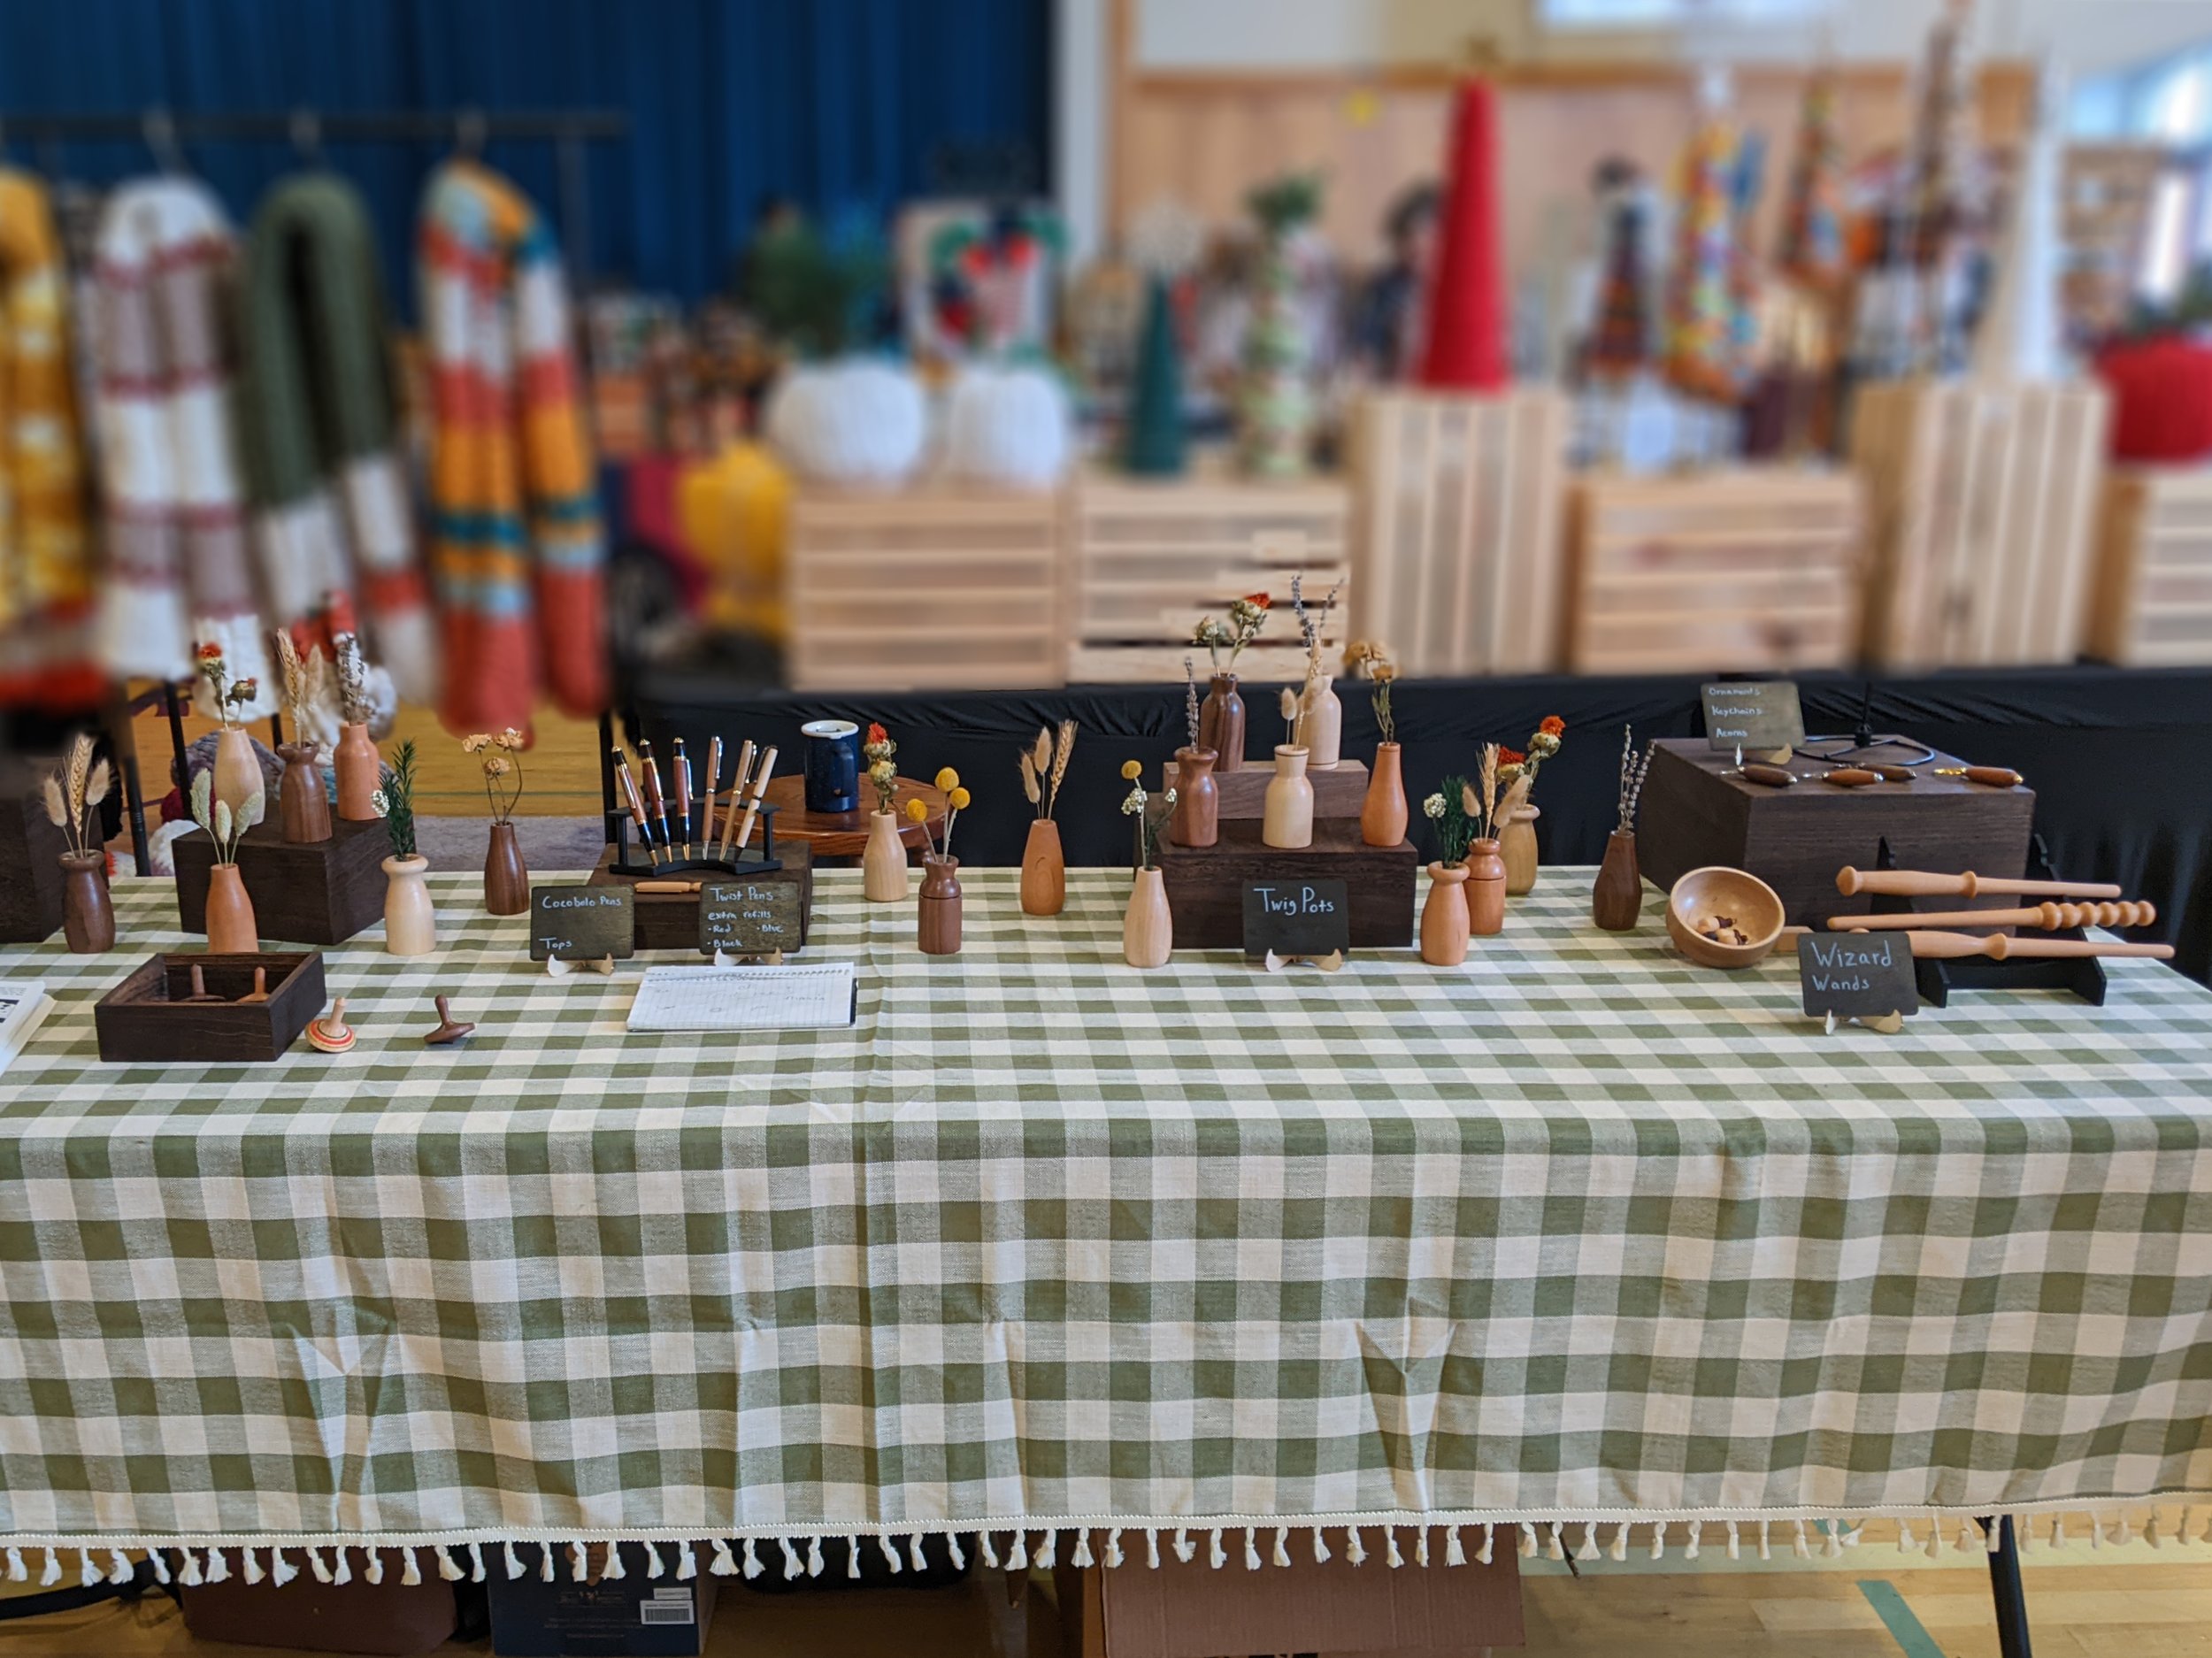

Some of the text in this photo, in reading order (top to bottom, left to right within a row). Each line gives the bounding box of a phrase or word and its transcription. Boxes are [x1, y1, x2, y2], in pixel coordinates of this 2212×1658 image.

[1711, 705, 1763, 718] Keychains
[1716, 727, 1748, 738] Acorns
[709, 886, 774, 902] Twist Pens
[599, 895, 622, 907] Pens
[1253, 887, 1334, 917] Twig Pots
[708, 910, 772, 921] extra refills
[538, 937, 572, 950] Tops
[1810, 940, 1892, 968] Wizard
[1812, 973, 1870, 991] Wands
